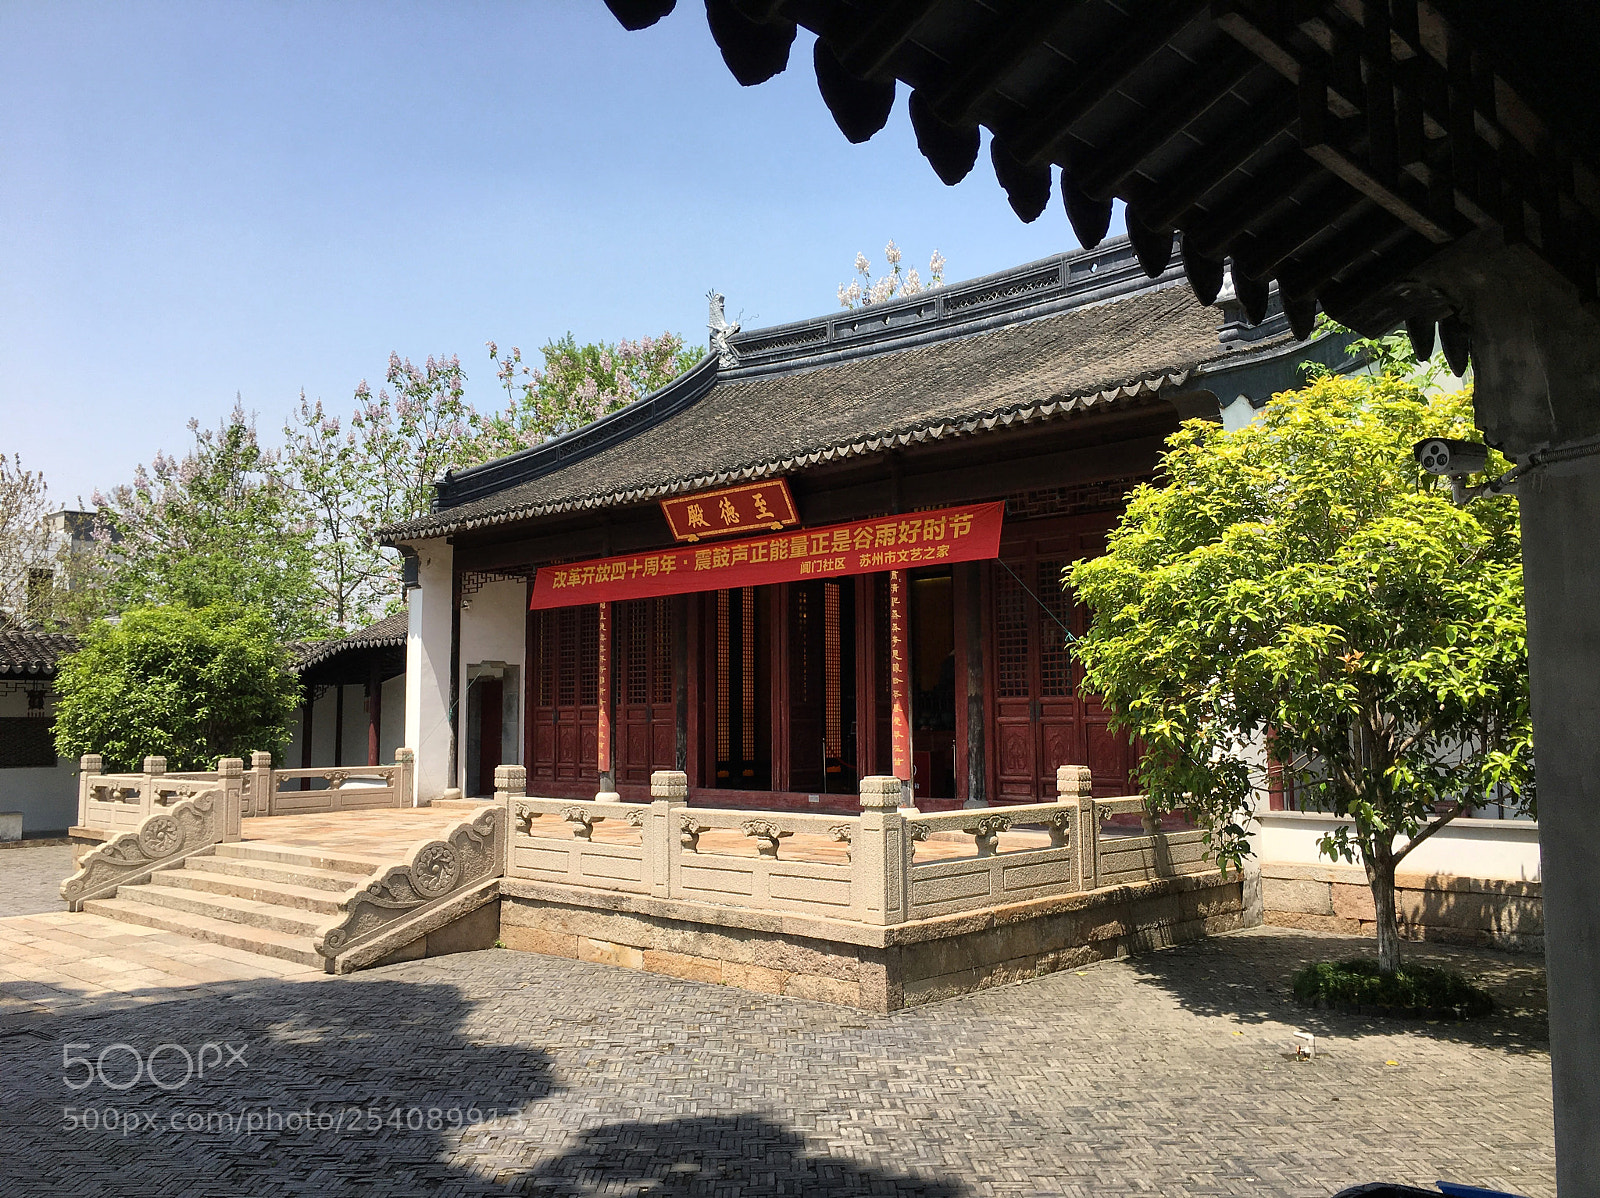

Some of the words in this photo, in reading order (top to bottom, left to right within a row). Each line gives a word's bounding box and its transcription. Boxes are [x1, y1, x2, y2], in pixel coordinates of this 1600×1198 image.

[859, 543, 951, 568] 苏州市文艺之家
